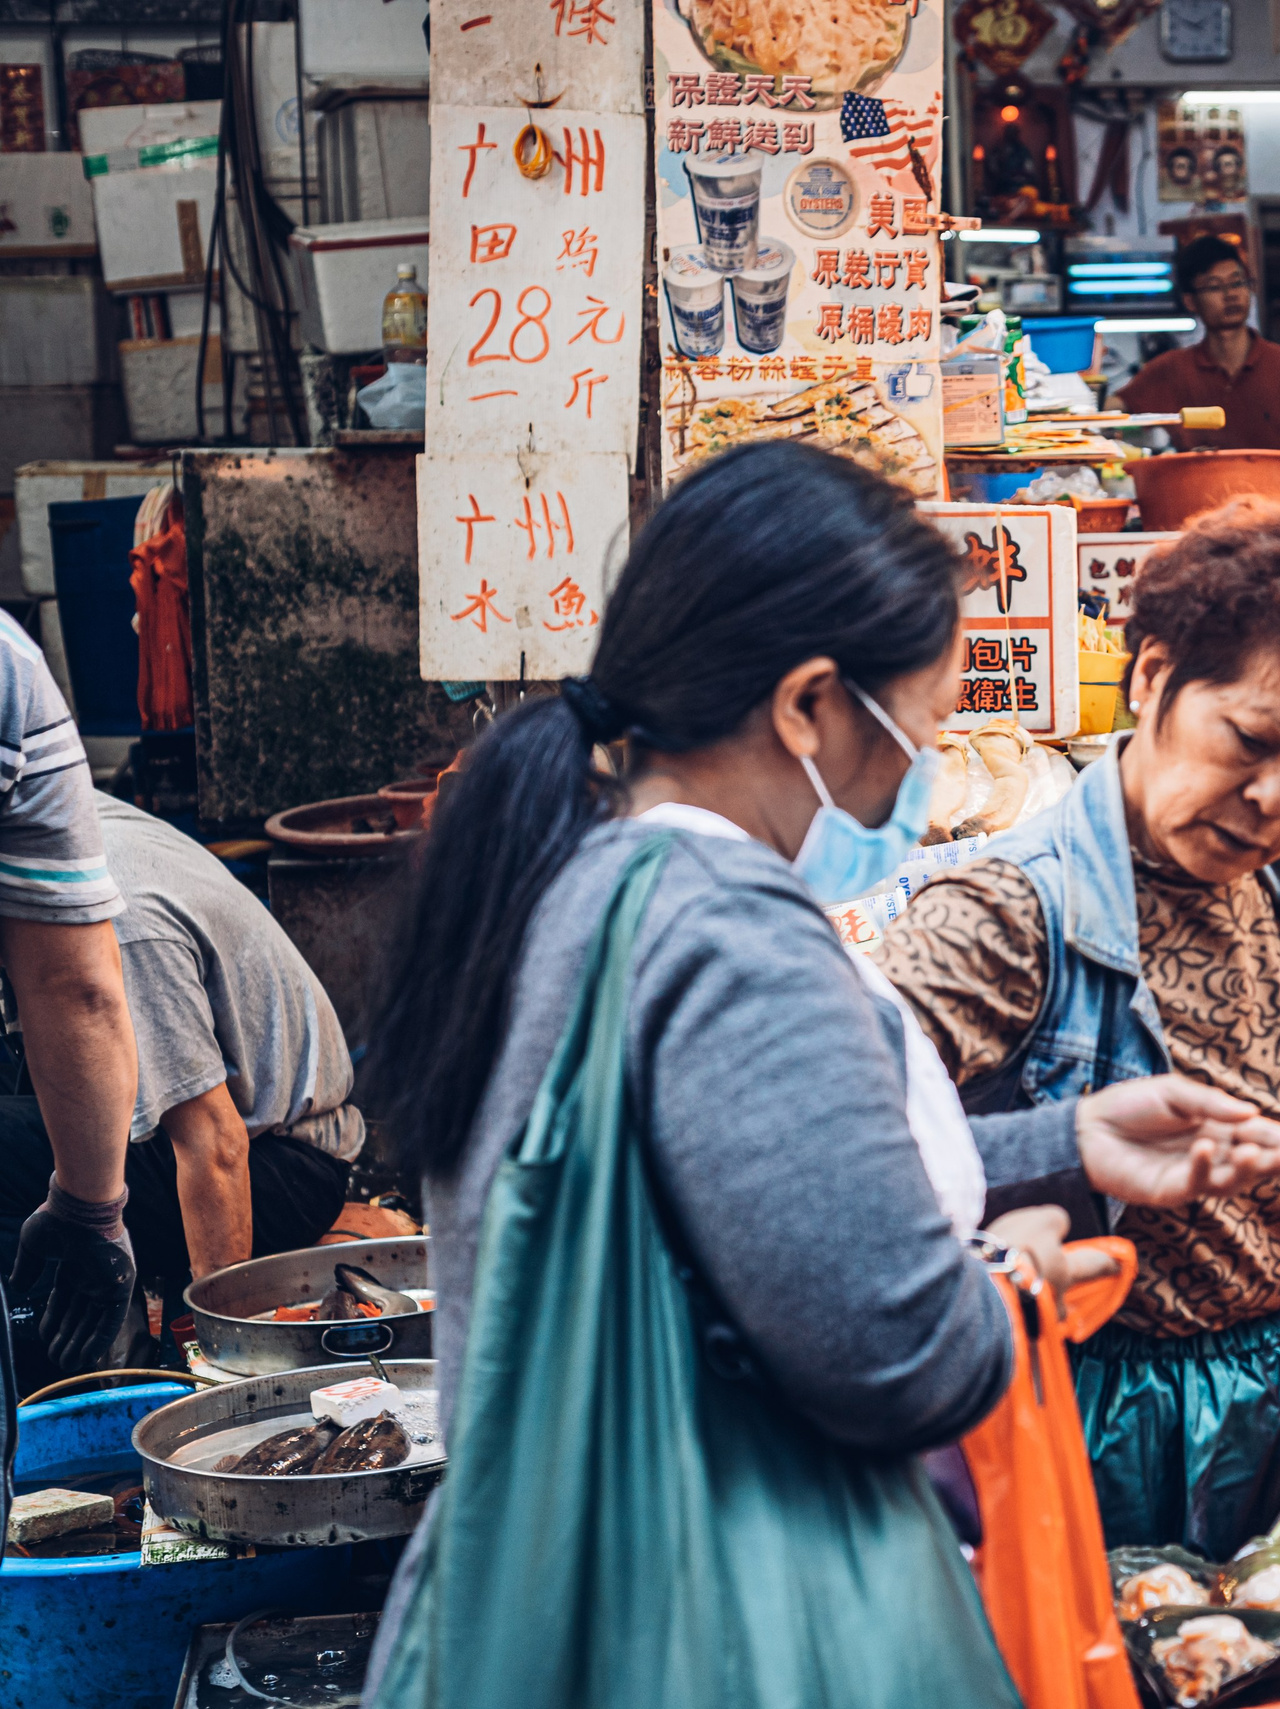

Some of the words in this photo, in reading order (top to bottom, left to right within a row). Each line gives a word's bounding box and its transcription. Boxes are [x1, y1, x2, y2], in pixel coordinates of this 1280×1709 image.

[667, 72, 817, 109] 保證天天
[667, 116, 816, 155] 新鮮送到
[811, 248, 930, 290] 原裝行貨
[815, 303, 933, 345] 原桶蠔肉
[961, 636, 1037, 673] 包片
